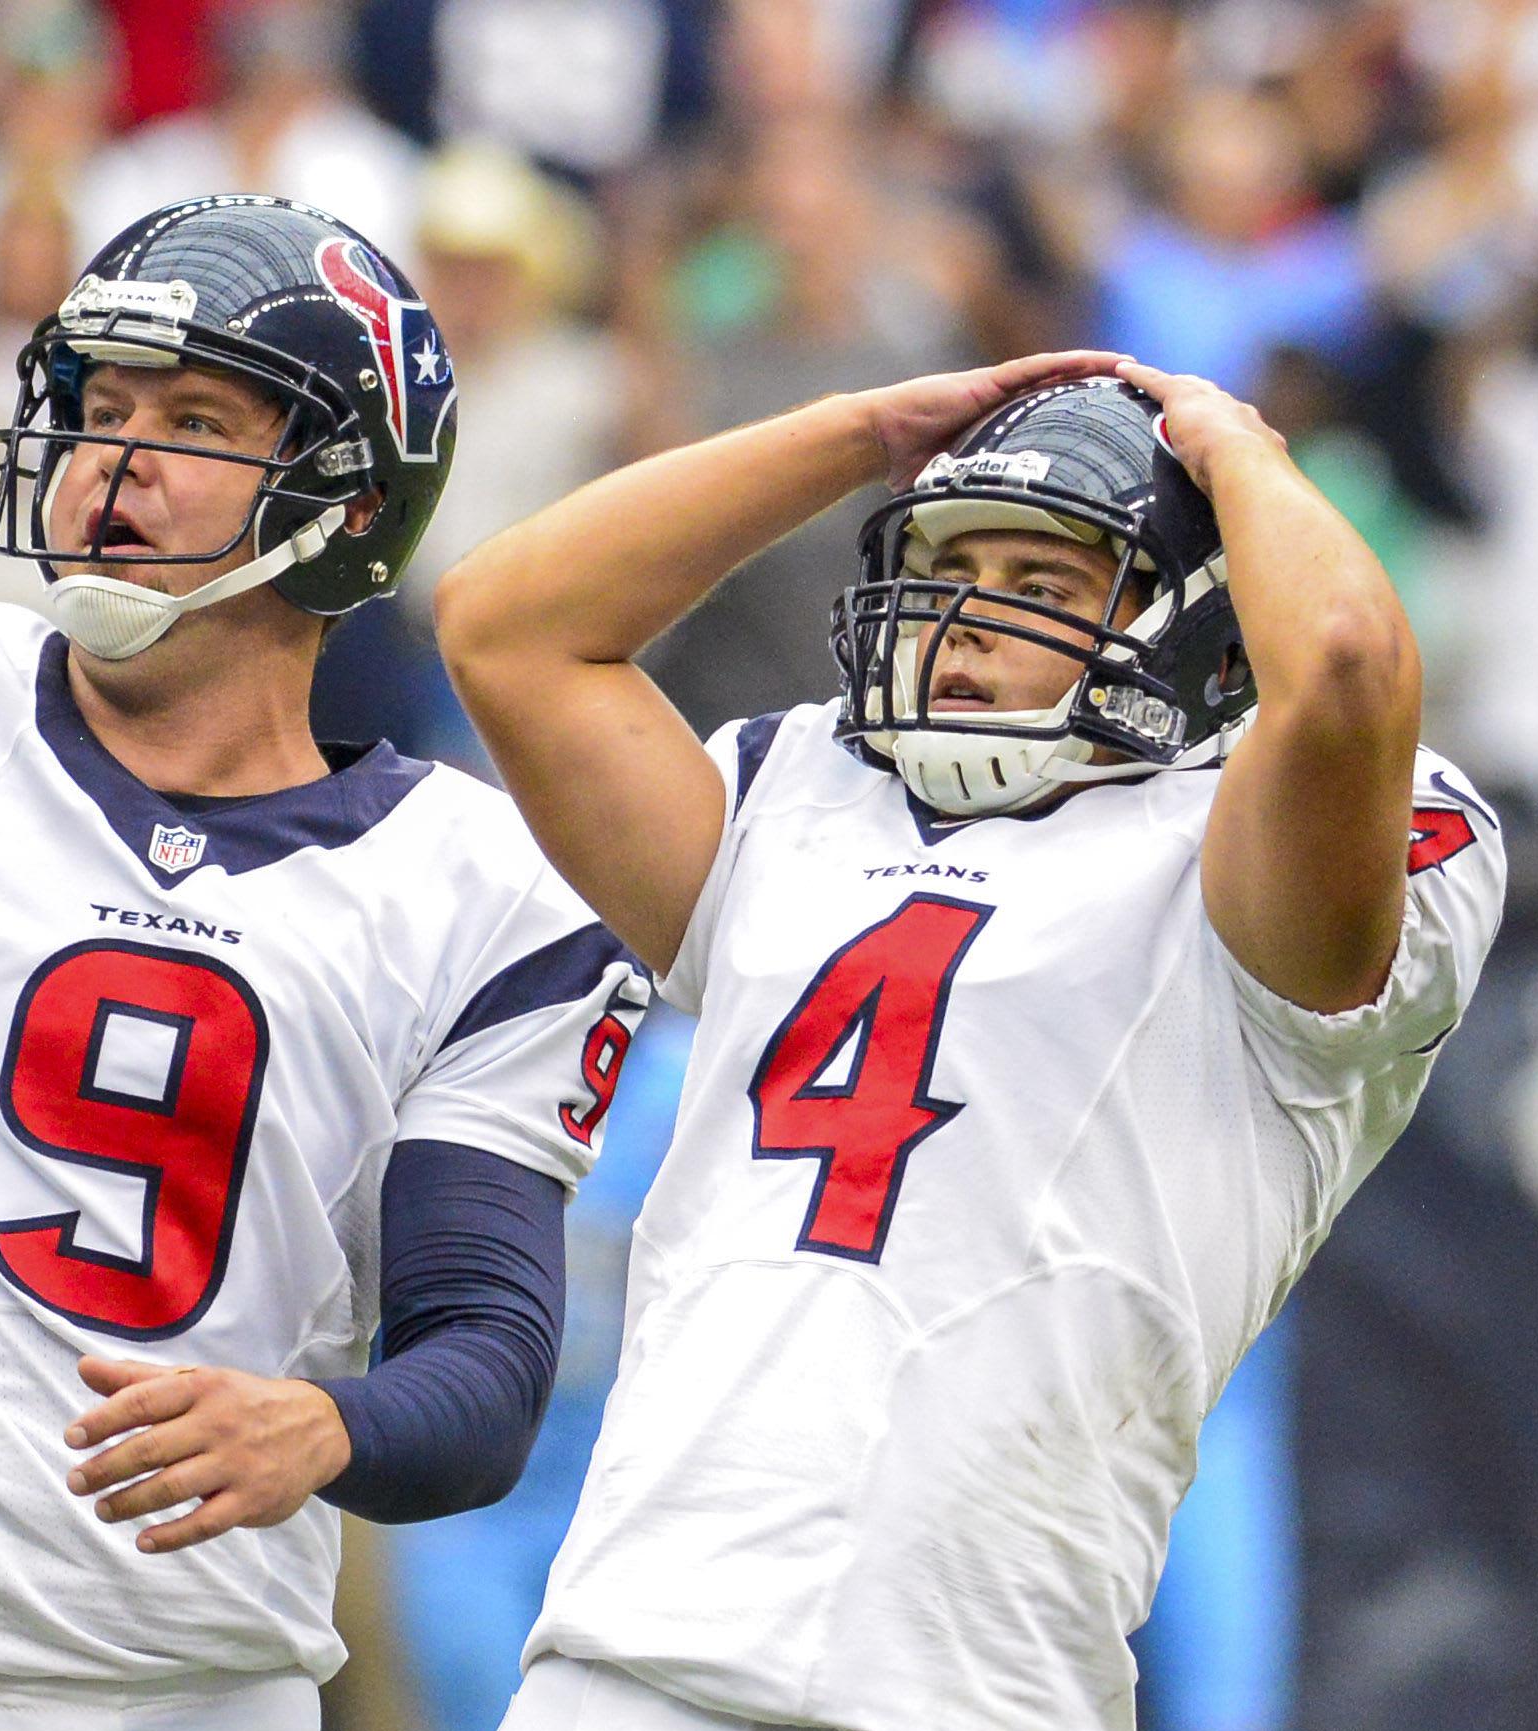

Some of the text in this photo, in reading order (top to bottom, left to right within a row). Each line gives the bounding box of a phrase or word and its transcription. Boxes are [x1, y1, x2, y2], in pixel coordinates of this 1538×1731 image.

[157, 844, 192, 865] NFL
[863, 863, 990, 883] TEXANS
[89, 903, 244, 945] TEXANS
[558, 1010, 633, 1150] 9
[747, 891, 997, 1265] 4
